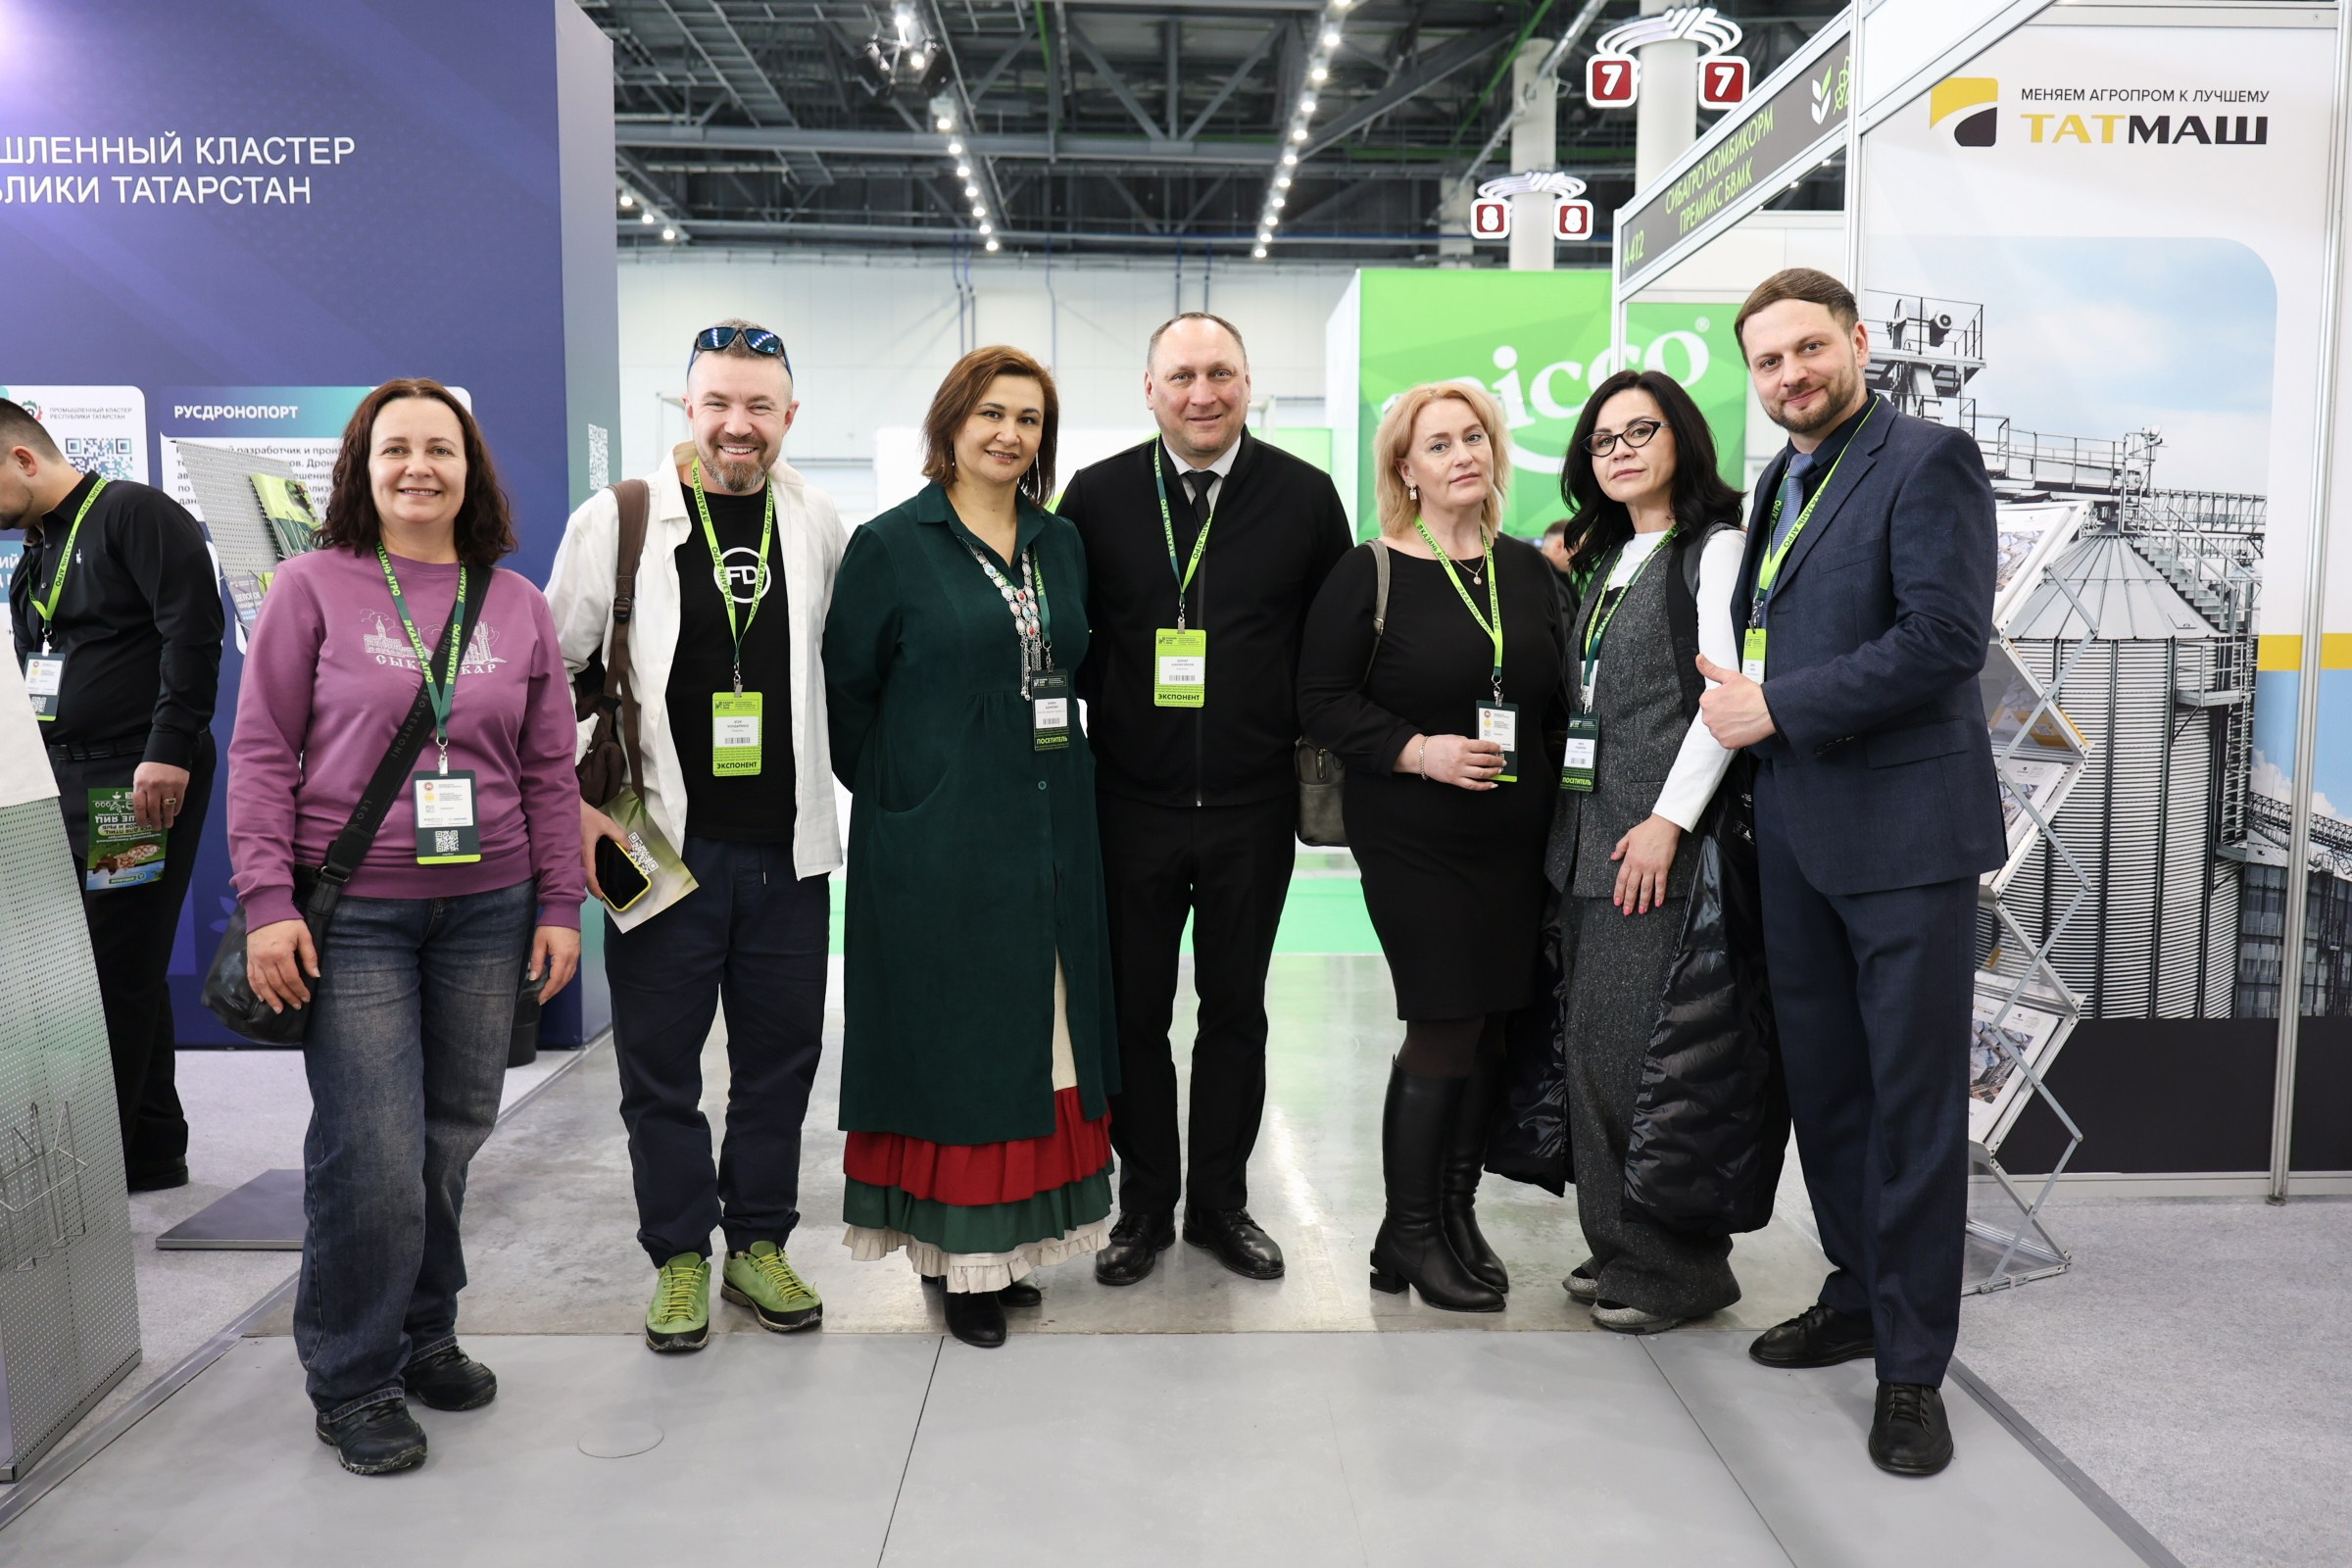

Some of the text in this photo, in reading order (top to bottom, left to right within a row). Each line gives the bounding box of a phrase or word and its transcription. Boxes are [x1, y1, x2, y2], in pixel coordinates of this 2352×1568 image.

[1602, 65, 1622, 96] 7
[1715, 67, 1736, 97] 7
[2021, 88, 2270, 103] МЕНЯЕМ АГРОПРОМ К ЛУЧШЕМУ
[2021, 114, 2268, 145] ТАТМАШ
[196, 135, 356, 166] КЛАСТЕР
[1666, 105, 1774, 215] СИБАГРО КОМБИКОРМ
[0, 175, 312, 205] ЛИКИ ТАТАРСТАН
[1680, 157, 1753, 235] ПРЕМИКС БВМК
[1482, 206, 1498, 231] 8
[1565, 208, 1582, 232] 8
[1623, 228, 1644, 270] А412
[173, 405, 299, 421] РУСДРОНОПОРТ
[80, 500, 91, 515] АГРО
[696, 486, 710, 515] КАЗАНЬ
[1772, 500, 1782, 519] АГРО
[1160, 498, 1176, 551] КАЗАНЬ АГРО
[1784, 526, 1799, 548] АГРО
[55, 537, 73, 587] КАЗАНЬ АГРО
[1193, 540, 1203, 560] АГРО
[1419, 527, 1448, 568] КАЗАНЬ АГРО
[387, 575, 400, 596] АГРО
[711, 547, 733, 602] КАЗАНЬ АГРО
[751, 564, 764, 617] КАЗАНЬ АГРО
[1460, 588, 1493, 634] КАЗАНЬ АГРО
[1599, 582, 1629, 633] КАЗАНЬ АГРО
[406, 623, 433, 683] КАЗАНЬ АГРО
[447, 646, 459, 678] КАЗАНЬ
[1037, 736, 1067, 745] ПОСЕТИТЕЛЬ
[1562, 777, 1592, 786] ПОСЕТИТЕЛЬ
